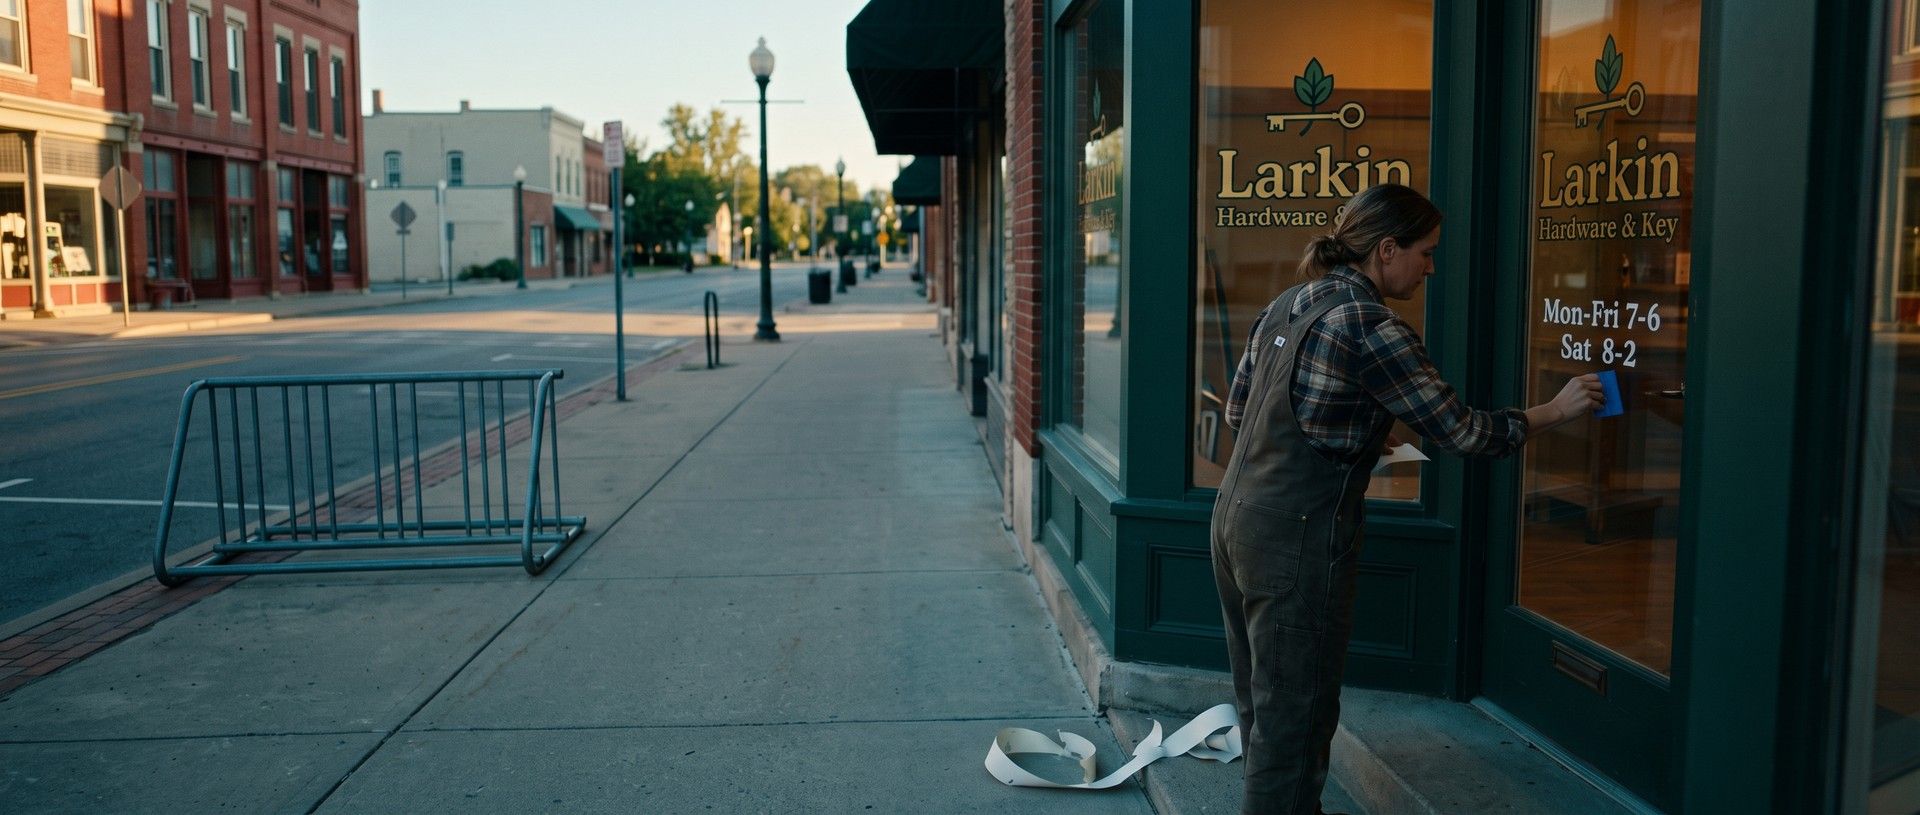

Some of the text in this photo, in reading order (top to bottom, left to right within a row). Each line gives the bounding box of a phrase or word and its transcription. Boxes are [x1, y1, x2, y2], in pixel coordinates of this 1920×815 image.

[1217, 146, 1411, 199] Larkin
[1540, 137, 1681, 208] Larkin
[1216, 205, 1328, 227] Hardware
[1538, 211, 1679, 243] Hardware & Key
[1543, 297, 1661, 332] Mon-Fri 7-6
[1560, 333, 1637, 368] Sat 8-2
